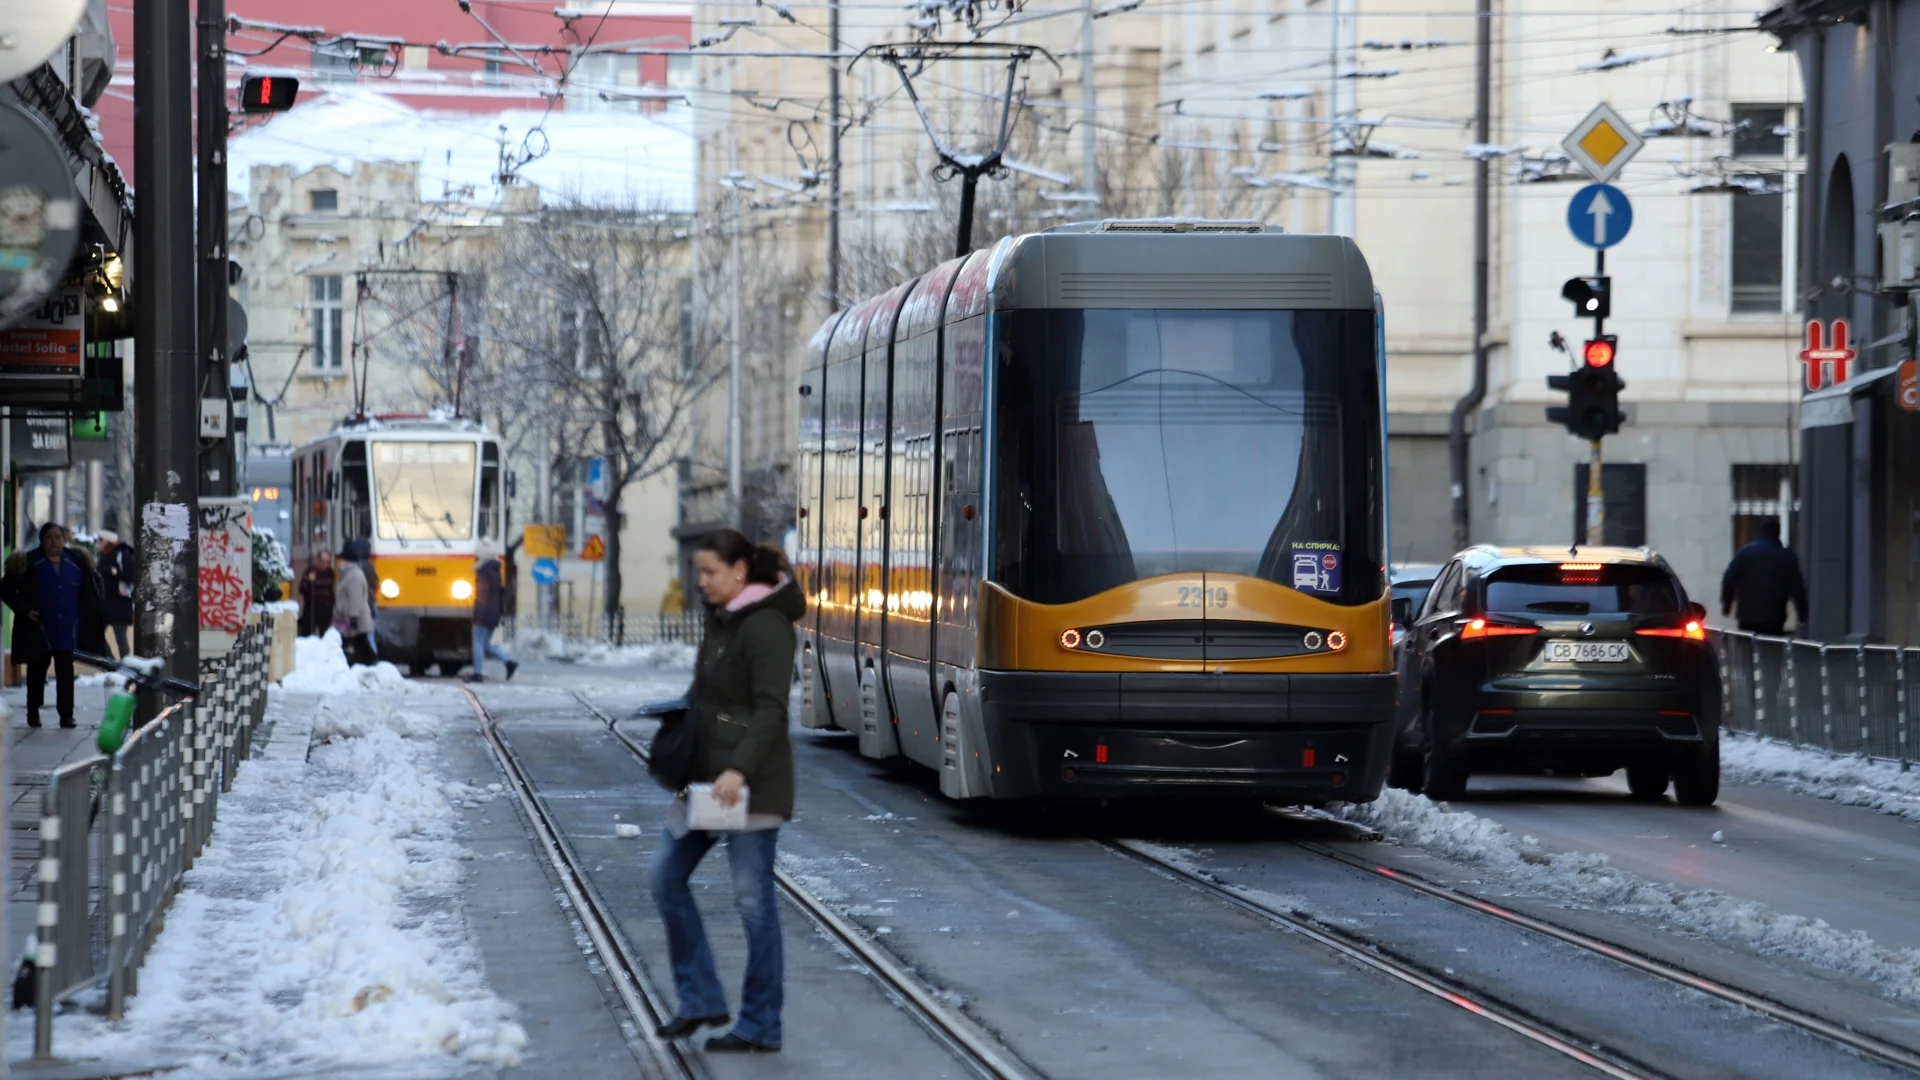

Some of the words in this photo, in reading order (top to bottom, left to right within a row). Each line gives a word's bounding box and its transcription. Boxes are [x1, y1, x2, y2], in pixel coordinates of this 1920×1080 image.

[35, 342, 67, 354] Sofia
[1305, 542, 1340, 550] СПИРКА:
[1177, 586, 1228, 608] 2319
[1553, 643, 1572, 659] CB
[1574, 643, 1606, 659] 7686
[1608, 643, 1626, 659] CK
